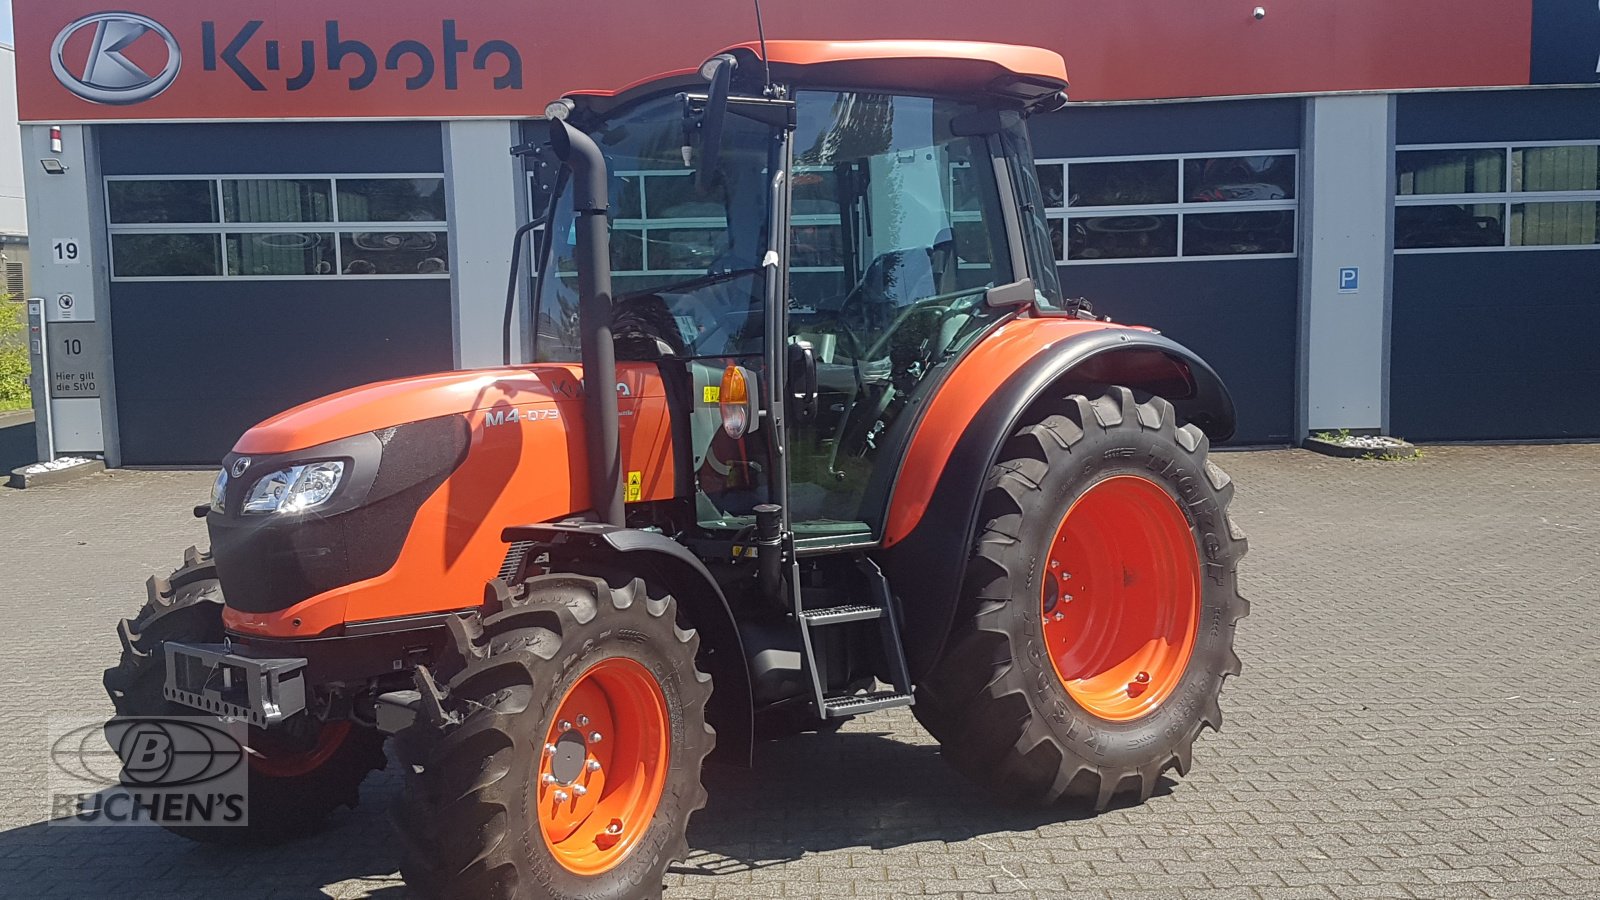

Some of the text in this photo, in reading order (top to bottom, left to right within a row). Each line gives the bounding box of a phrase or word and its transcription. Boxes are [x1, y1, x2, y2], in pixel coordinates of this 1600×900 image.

[202, 19, 523, 91] Kubota
[54, 242, 78, 259] 19
[1341, 269, 1356, 287] P
[64, 339, 82, 355] 10
[56, 372, 75, 381] Hier
[56, 382, 96, 391] die StVO
[485, 408, 560, 427] M4-073
